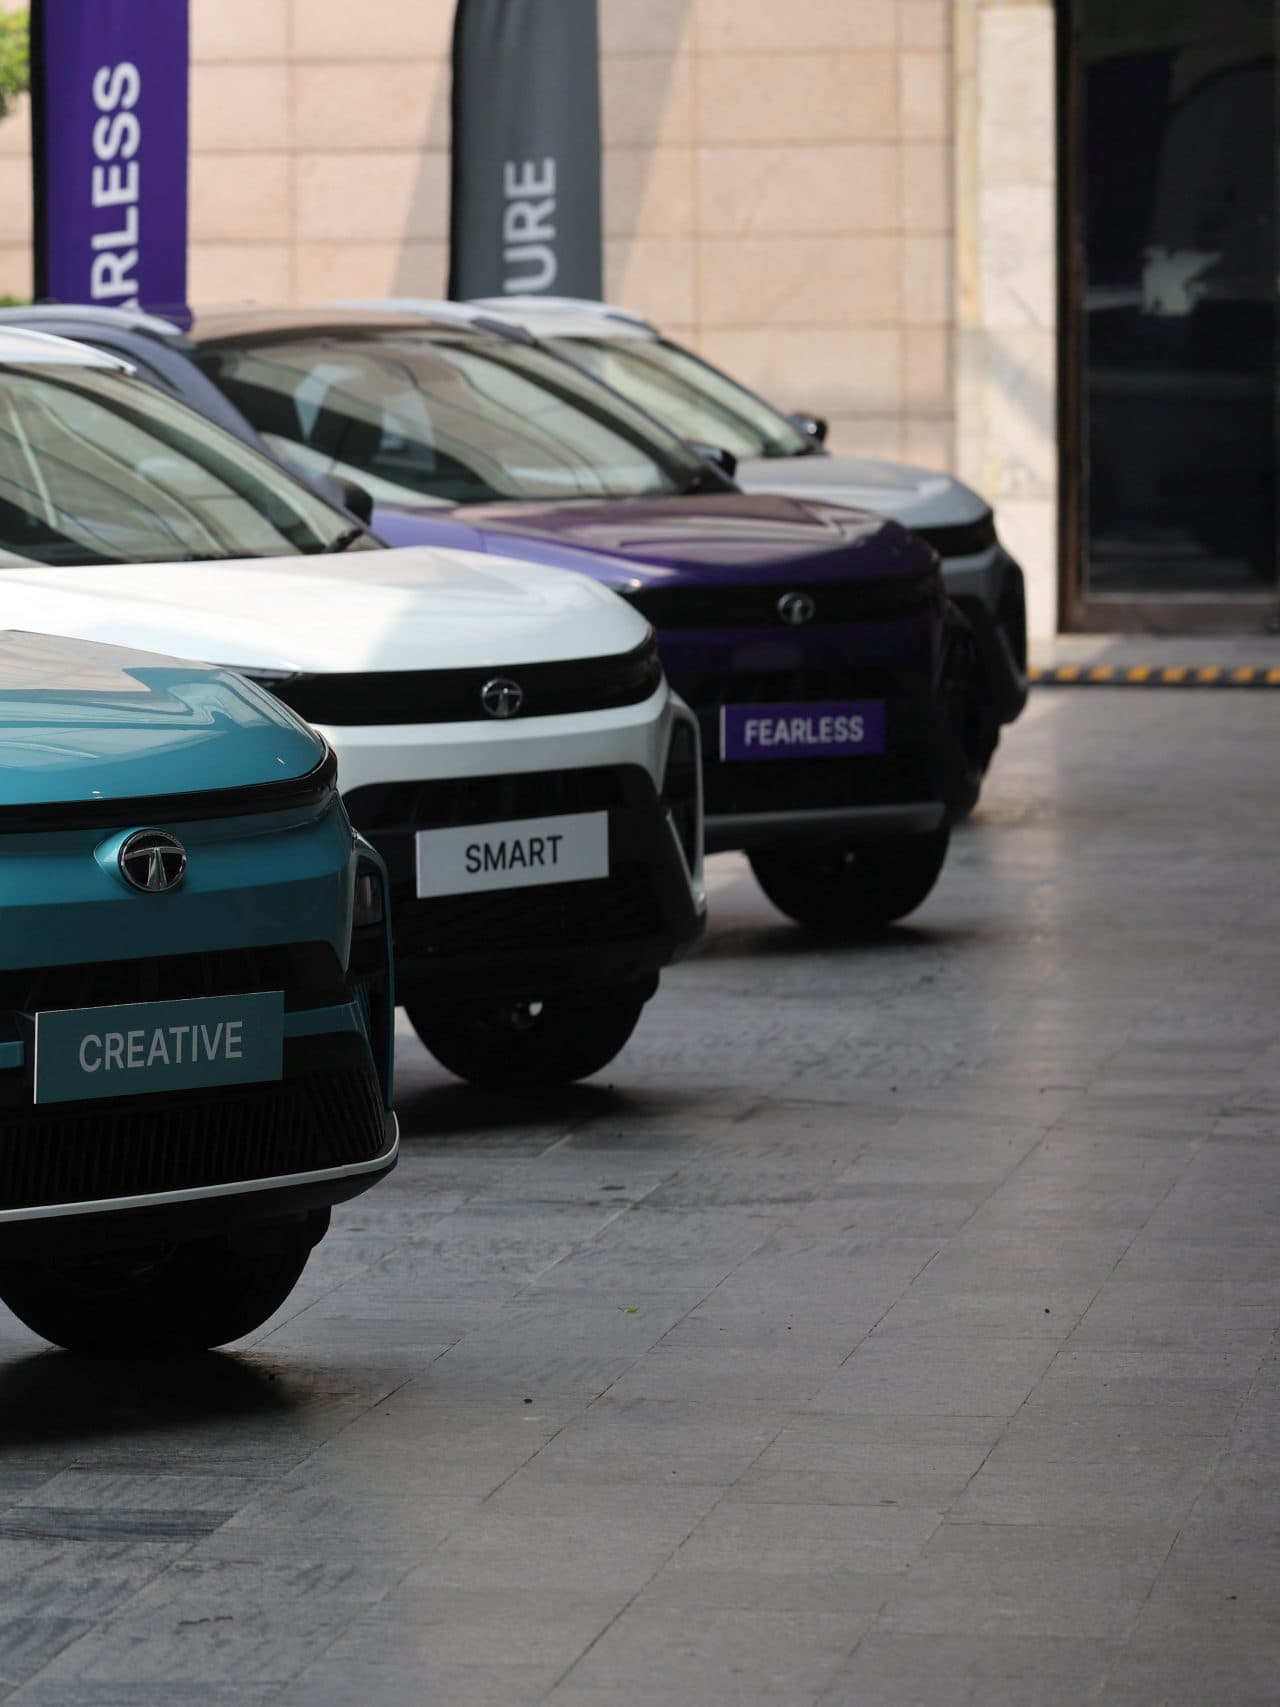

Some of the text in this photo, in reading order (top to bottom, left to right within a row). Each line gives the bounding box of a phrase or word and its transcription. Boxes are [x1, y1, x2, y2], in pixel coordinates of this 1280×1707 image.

[744, 715, 864, 746] FEARLESS
[465, 835, 563, 874] SMART
[79, 1021, 243, 1072] CREATIVE
